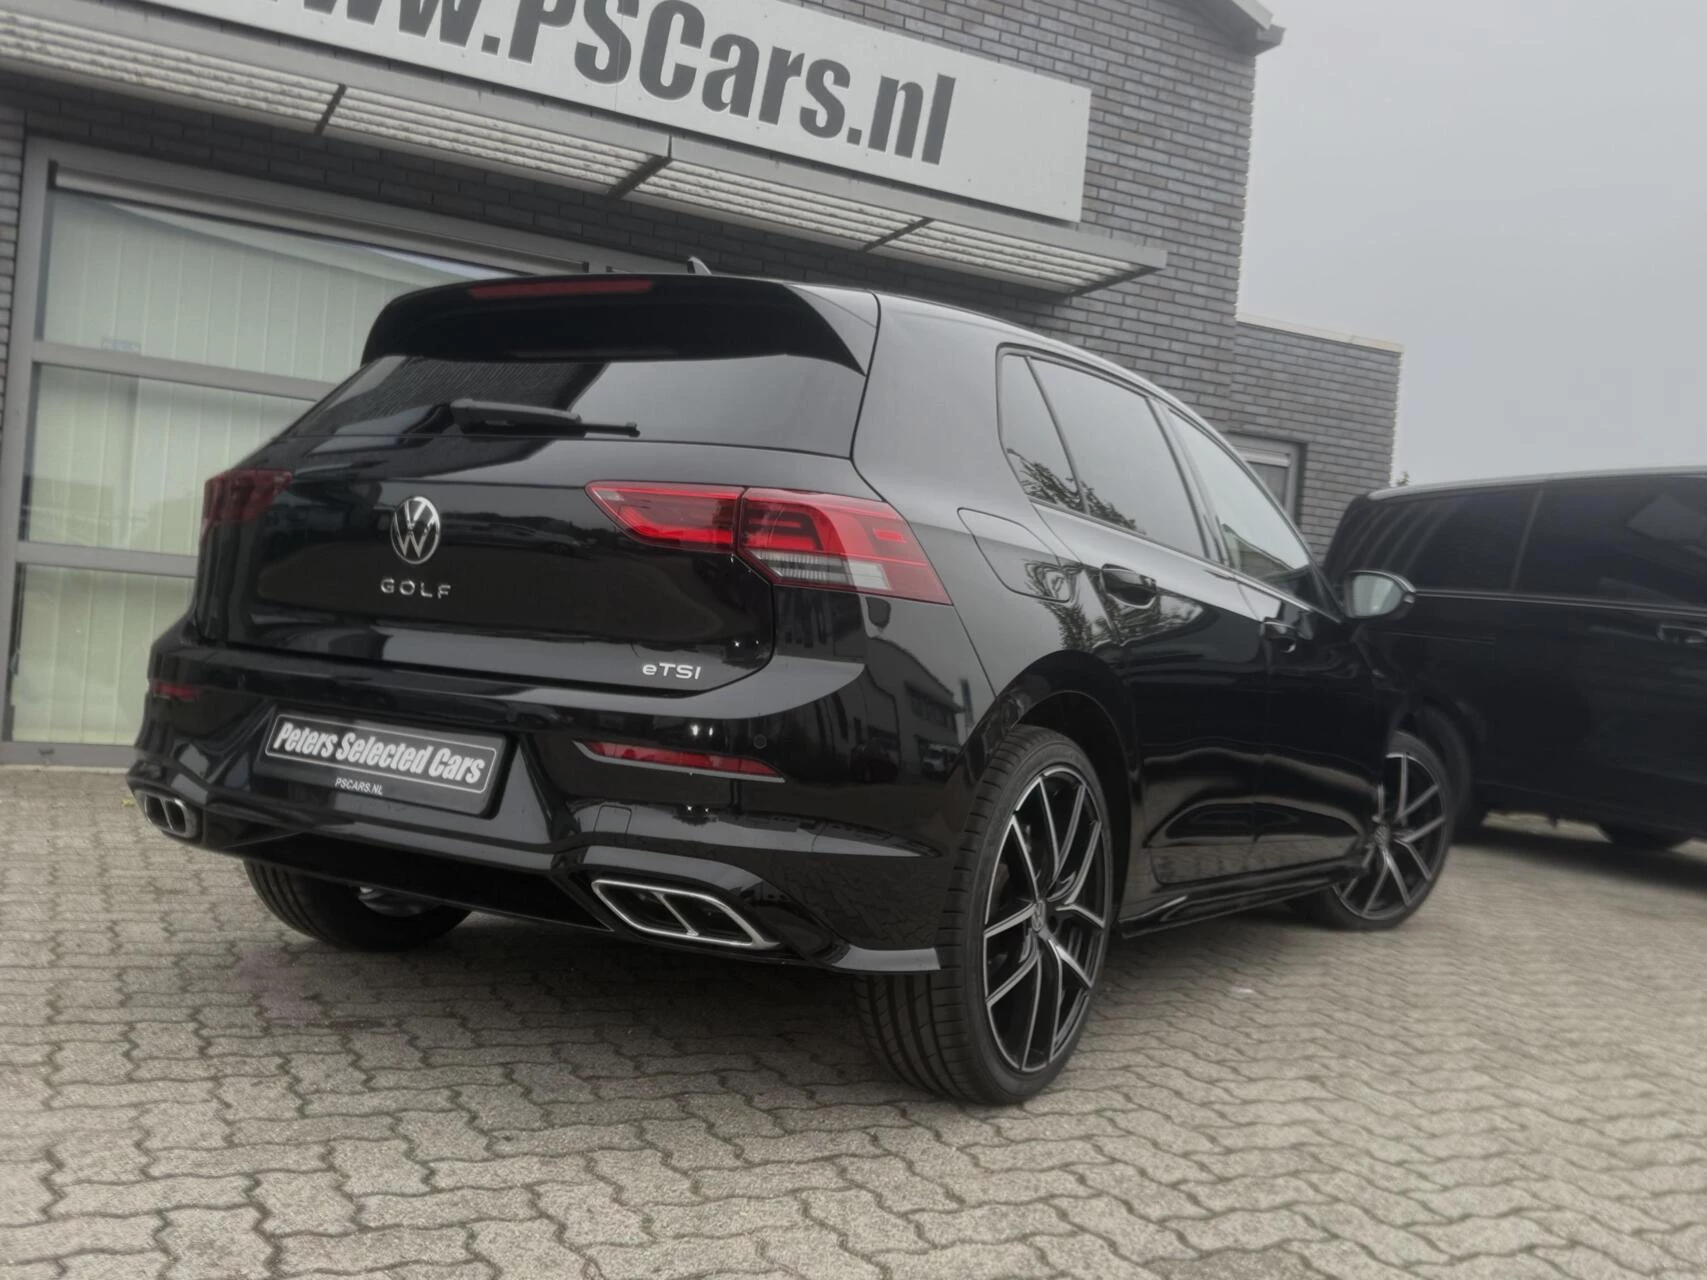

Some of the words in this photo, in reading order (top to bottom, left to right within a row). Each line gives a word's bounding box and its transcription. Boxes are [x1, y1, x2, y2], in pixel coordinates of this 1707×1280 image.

[268, 0, 956, 166] w.PSCars.nl
[380, 578, 452, 599] GOLF
[642, 662, 701, 680] eTSI
[273, 722, 338, 758] Peters
[335, 732, 433, 775] Selected
[428, 747, 485, 784] Cars
[334, 776, 384, 796] PSCARS.NL
